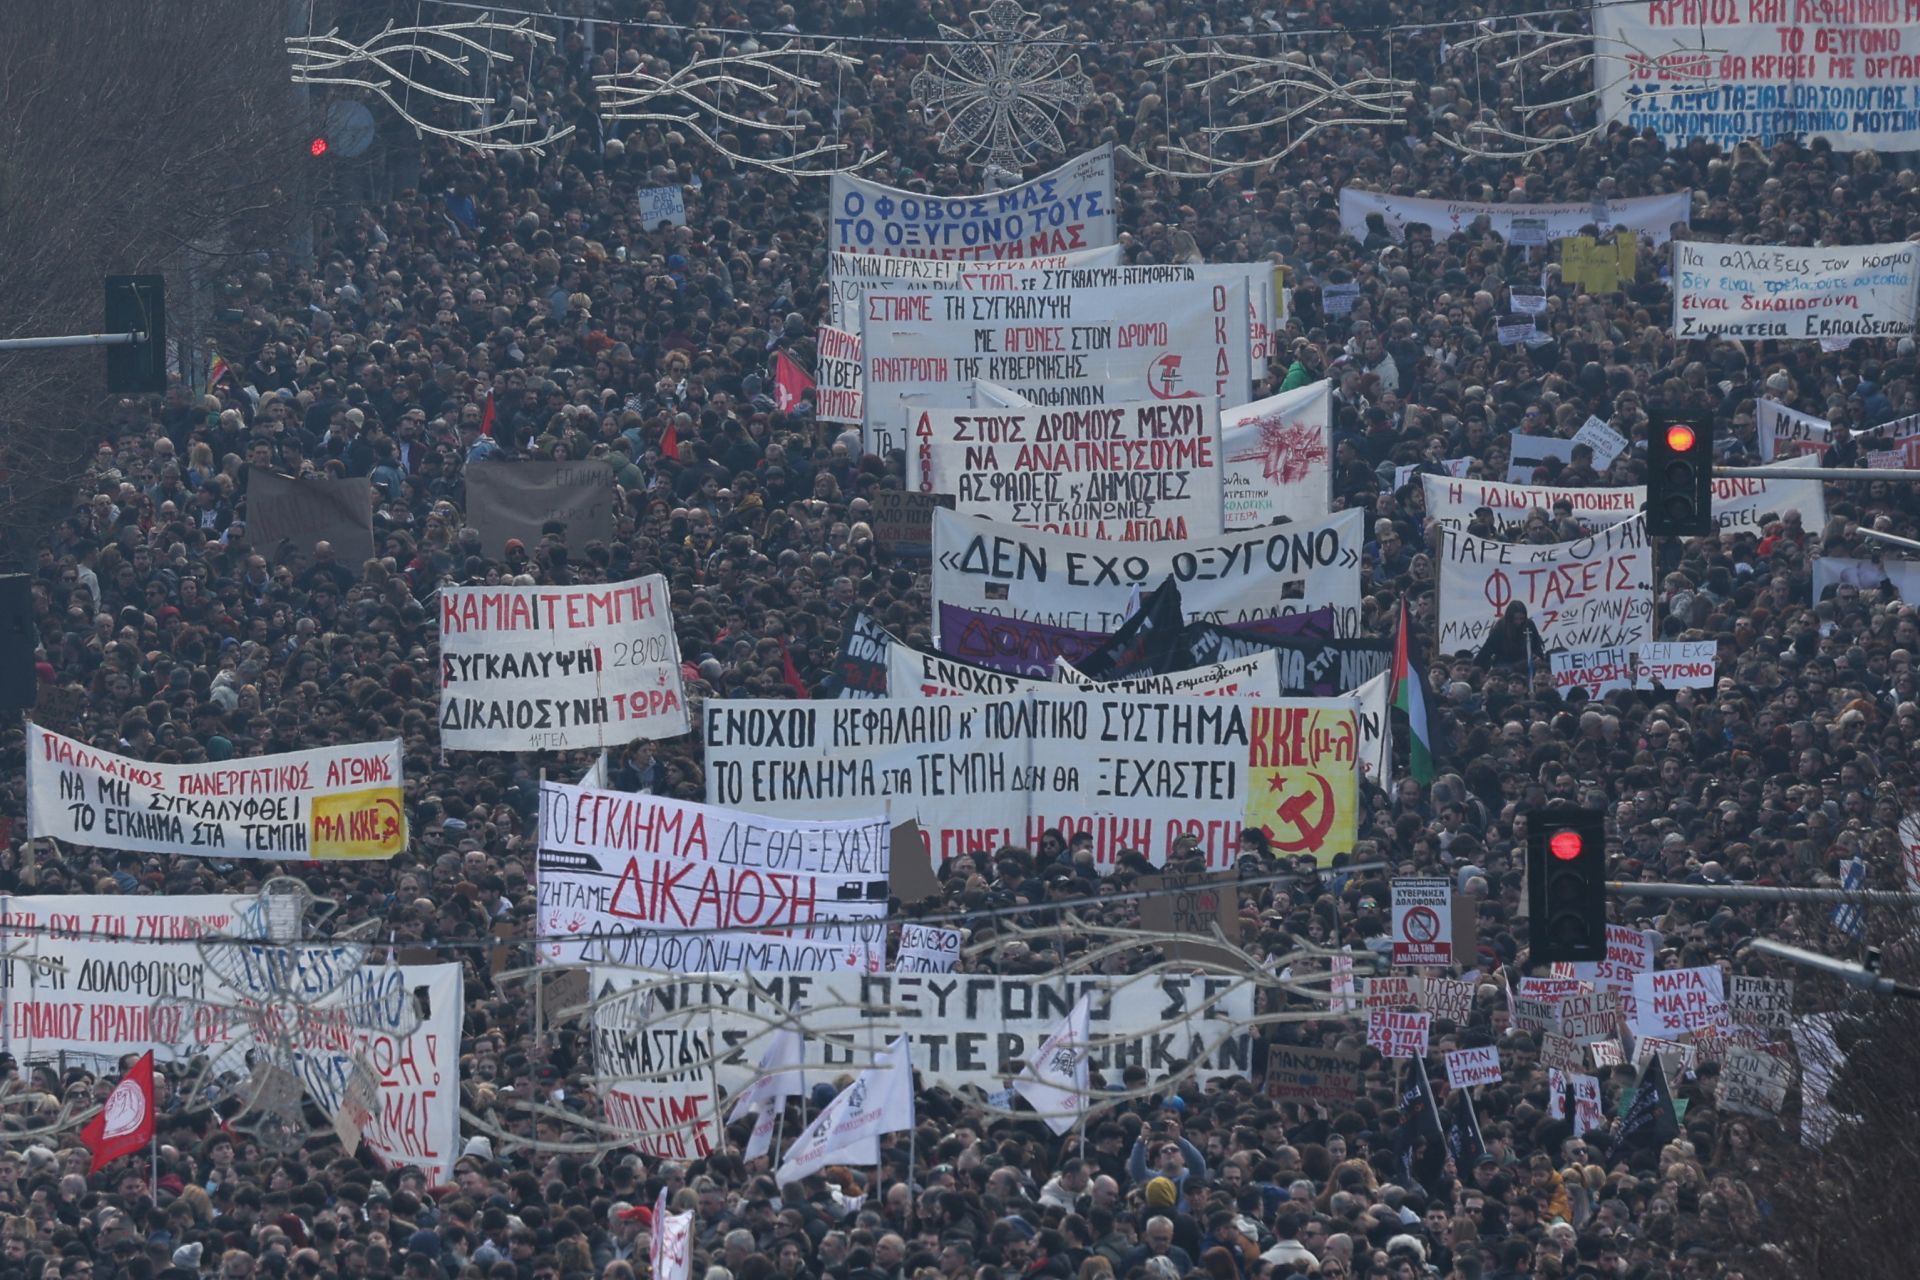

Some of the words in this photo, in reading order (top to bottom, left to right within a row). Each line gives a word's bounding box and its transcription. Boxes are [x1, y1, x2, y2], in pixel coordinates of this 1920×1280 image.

[1776, 27, 1804, 54] ΤΟ
[1814, 27, 1901, 54] ΟΞΥΓΟΝΟ
[1720, 55, 1746, 80] ΘΑ
[1751, 55, 1815, 80] ΚΡΙΘΕΙ
[1828, 57, 1854, 79] ΜΕ
[844, 191, 864, 217] Ο
[874, 195, 989, 220] ΦΟΒΟΣ
[999, 178, 1058, 212] ΜΑΣ
[834, 218, 874, 245] ΤΟ
[884, 214, 1023, 245] ΟΞΥΓΟΝΟ
[1030, 223, 1087, 257] ΜΑΣ
[831, 252, 848, 277] ΝΑ
[852, 255, 881, 277] ΜΗΝ
[885, 258, 951, 279] ΠΕΡΑΣΕΙ
[1683, 246, 1704, 267] Να
[1719, 251, 1810, 275] αλλάξεις
[1821, 258, 1850, 271] τον
[869, 296, 933, 321] ΣΠΑΜΕ
[944, 296, 965, 320] ΤΗ
[973, 296, 1071, 320] ΣΥΓΚΑΛΥΨΗ
[1741, 294, 1859, 312] δικαιοσύνη
[975, 329, 997, 352] ΜΕ
[1072, 326, 1110, 350] ΣΤΟΝ
[1118, 322, 1168, 348] ΔΡΟΜΟ
[872, 357, 948, 382] ΑΝΑΤΡΟΠΗ
[954, 357, 983, 382] ΤΗΣ
[989, 354, 1089, 381] ΚΥΒΕΡΝΗΣΗΣ
[953, 416, 1025, 443] ΣΤΟΥΣ
[1036, 409, 1125, 442] ΔΡΟΜΟΥΣ
[1137, 405, 1204, 438] ΜΕΧΡΙ
[966, 445, 998, 470] ΝΑ
[1015, 436, 1214, 472] ΑΝΑΠΝΕΥΣΟΥΜΕ
[959, 472, 1063, 503] ΑΣΦΑΛΕΙΣ
[1087, 471, 1191, 501] ΔΗΜΟΣΙΕΣ
[1450, 484, 1462, 505] Η
[1012, 501, 1156, 522] ΣΥΓΚΟΙΝΩΝΙΕΣ
[1441, 531, 1513, 564] ΠΑΡΕ
[1530, 549, 1558, 563] ΜΕ
[1067, 553, 1149, 586] ΕΧΩ
[613, 634, 669, 668] 28/02
[1558, 650, 1624, 669] ΤΕΜΠΗ
[1641, 644, 1671, 660] ΔΕΝ
[441, 697, 609, 730] ΔΙΚΑΙΟΣΥΝΗ
[613, 690, 681, 721] ΤΩΡΑ
[707, 707, 817, 748] ΕΝΟΧΟΙ
[833, 704, 951, 746] ΚΕΦΑΛΑΙΟ
[985, 699, 1087, 740] ΠΟΛΙΤΙΚΟ
[1100, 702, 1248, 746] ΣΥΣΤΗΜΑ
[180, 761, 315, 796] ΠΑΝΕΡΓΑΤΙΚΟΣ
[326, 755, 393, 788] ΑΓΩΝΑΣ
[713, 761, 743, 804] ΤΟ
[752, 759, 876, 802] ΕΓΚΛΗΜΑ
[881, 768, 912, 795] ΣΤΑ
[917, 752, 1004, 797] ΤΕΜΠΗ
[1053, 768, 1079, 792] ΘΑ
[1098, 758, 1236, 800] ΞΕΧΑΣΤΕΙ
[60, 771, 85, 801] ΝΑ
[100, 776, 131, 807] ΜΗ
[148, 793, 300, 821] ΣΥΓΚΑΛΥΦΘΕΙ
[68, 803, 96, 832] ΤΟ
[105, 808, 184, 844] ΕΓΚΛΗΜΑ
[192, 823, 226, 849] ΣΤΑ
[241, 821, 308, 852] ΤΕΜΠΗ
[350, 808, 380, 841] ΚΚΕ
[542, 790, 569, 844] ΤΟ
[575, 793, 709, 861] ΕΓΚΛΗΜΑ
[539, 881, 610, 910] ΖΗΤΑΜΕ
[1397, 889, 1445, 897] ΚΥΒΕΡΝΗΣΗ
[1595, 962, 1613, 979] 55
[1652, 972, 1704, 993] ΜΑΡΙΑ
[1161, 978, 1231, 1019] ΣΕ
[1562, 999, 1592, 1018] ΔΕΝ
[1653, 991, 1708, 1015] ΜΙΑΡΗ
[13, 1001, 86, 1042] ΕΝΙΑΙΟΣ
[1371, 1013, 1429, 1030] ΕΛΠΙΔΑ
[1662, 1013, 1681, 1029] 56
[1448, 1050, 1492, 1068] ΗΤΑΝ
